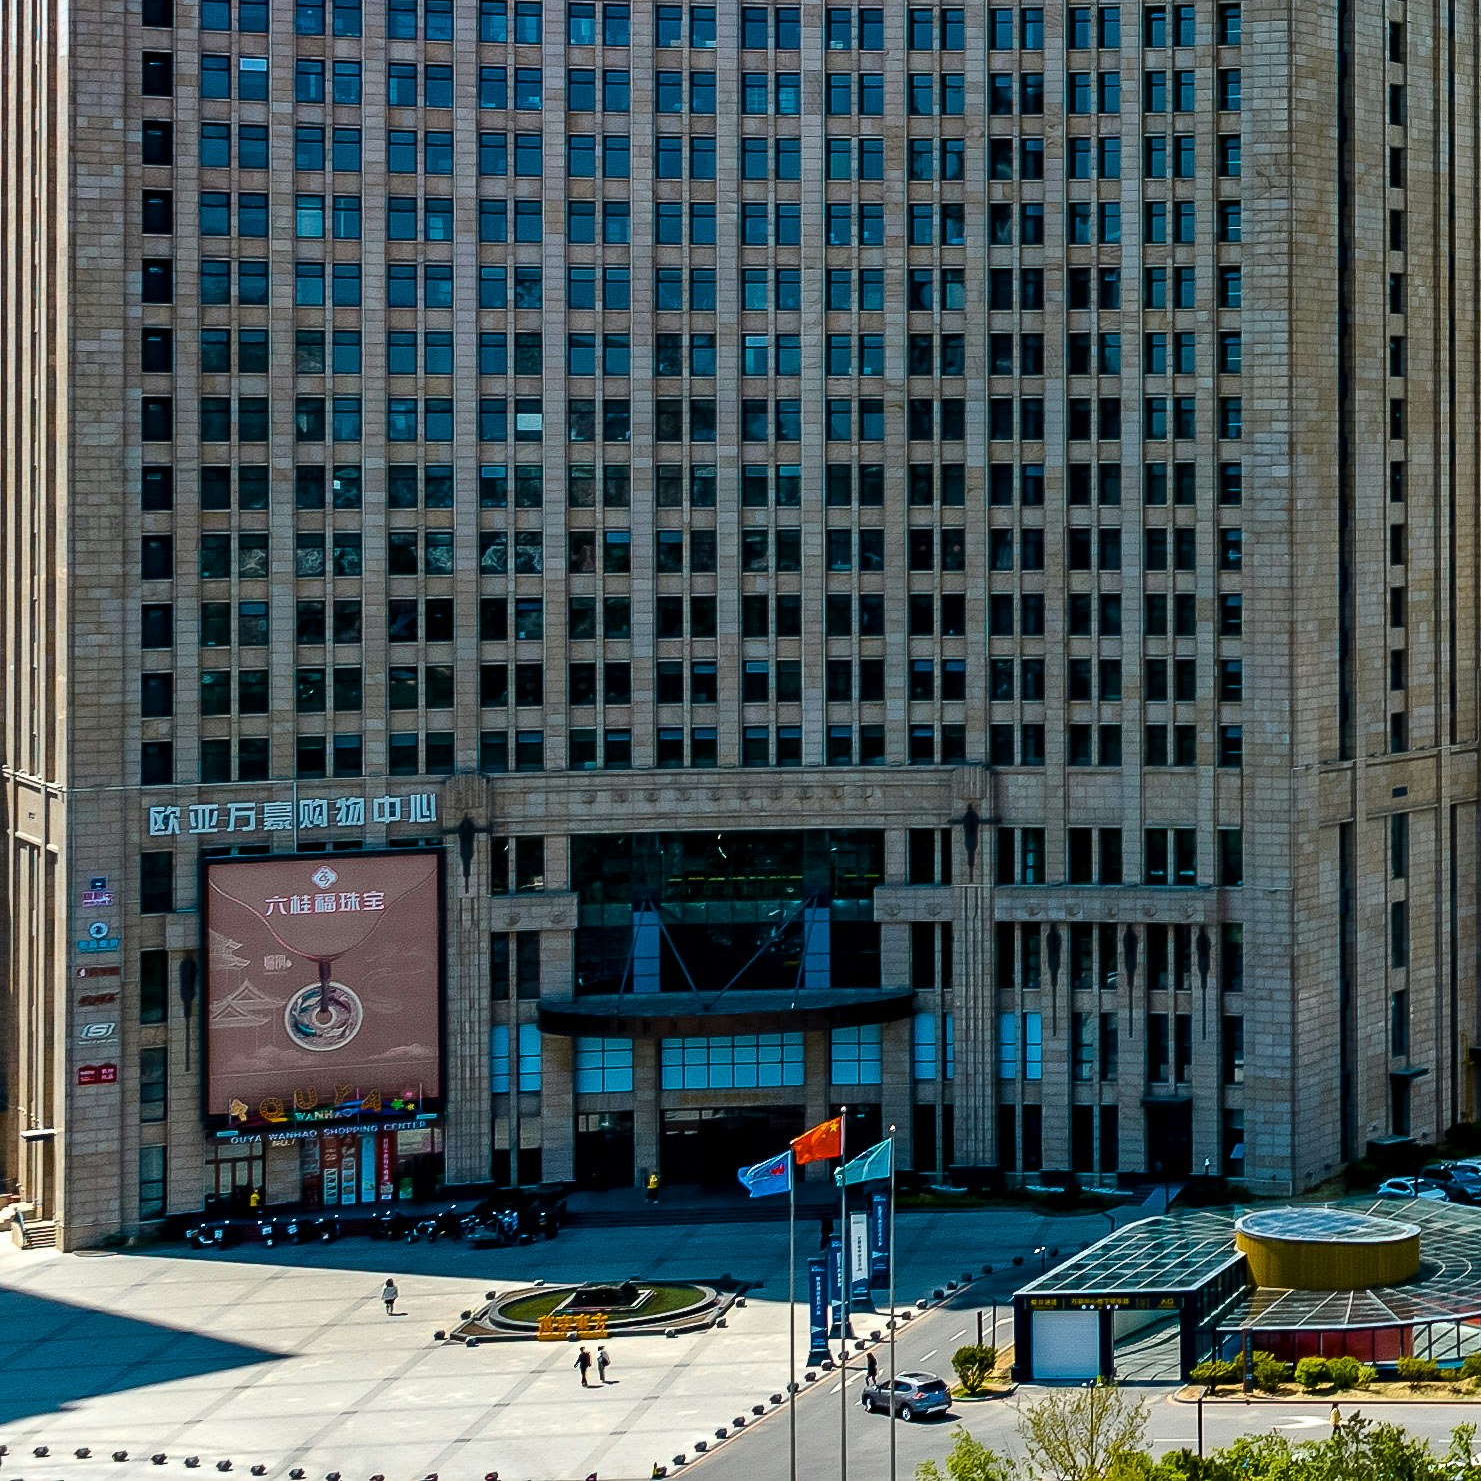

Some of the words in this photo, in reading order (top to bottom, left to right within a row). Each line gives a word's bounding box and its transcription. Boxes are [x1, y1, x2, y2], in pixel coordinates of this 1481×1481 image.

[150, 793, 437, 836] 欧亚万豪购物中心
[264, 890, 386, 916] 六桂福珠宝
[231, 1135, 261, 1144] OUYA
[269, 1130, 317, 1140] WANHAO
[324, 1125, 377, 1135] SHOPPING
